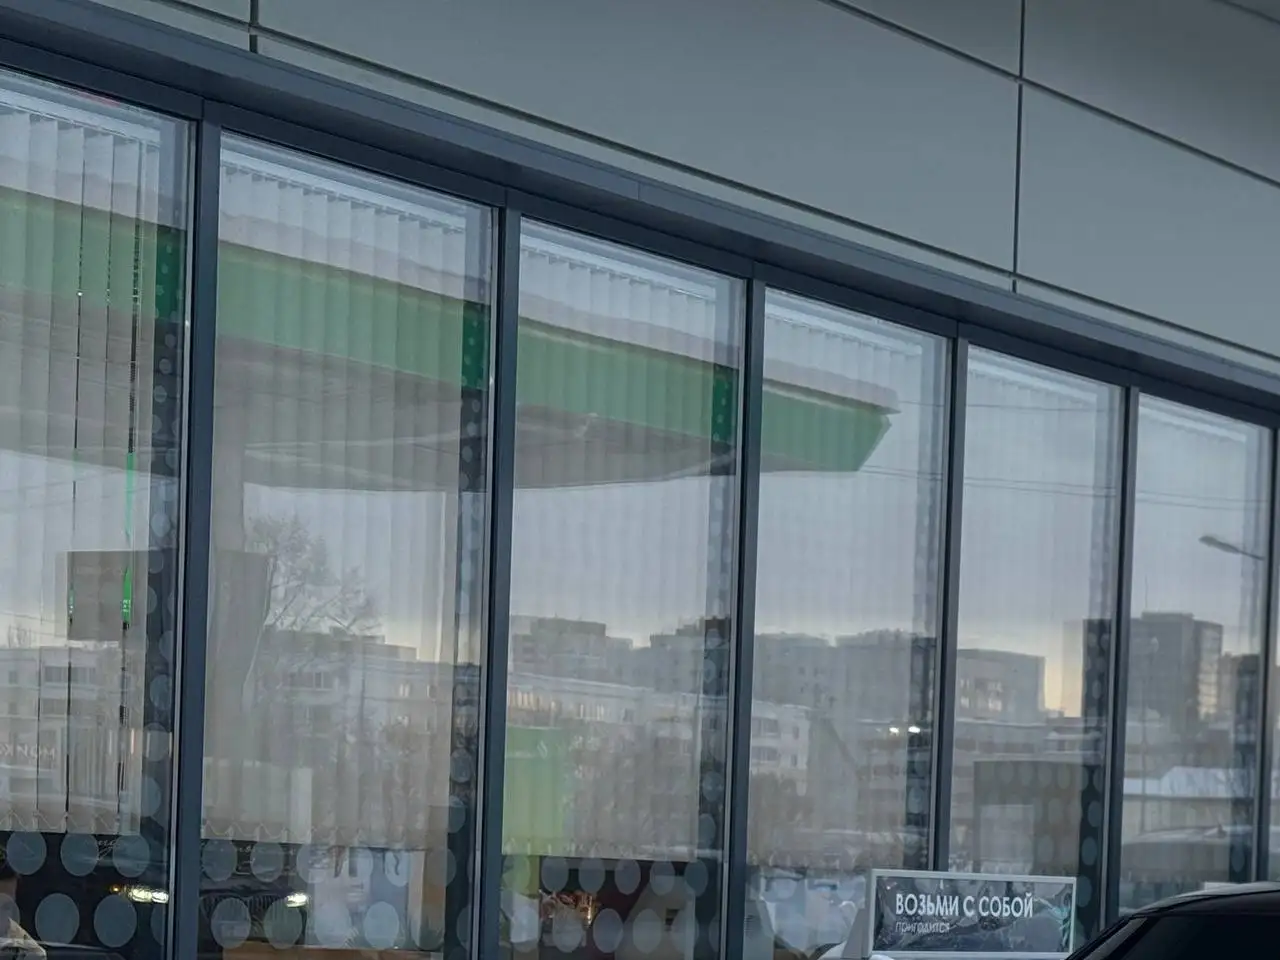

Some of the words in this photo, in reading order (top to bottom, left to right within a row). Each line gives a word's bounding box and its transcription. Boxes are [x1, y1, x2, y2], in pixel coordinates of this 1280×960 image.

[895, 893, 959, 917] ВОЗЬМИ
[963, 895, 976, 917] С
[978, 892, 1034, 918] СОБОЙ
